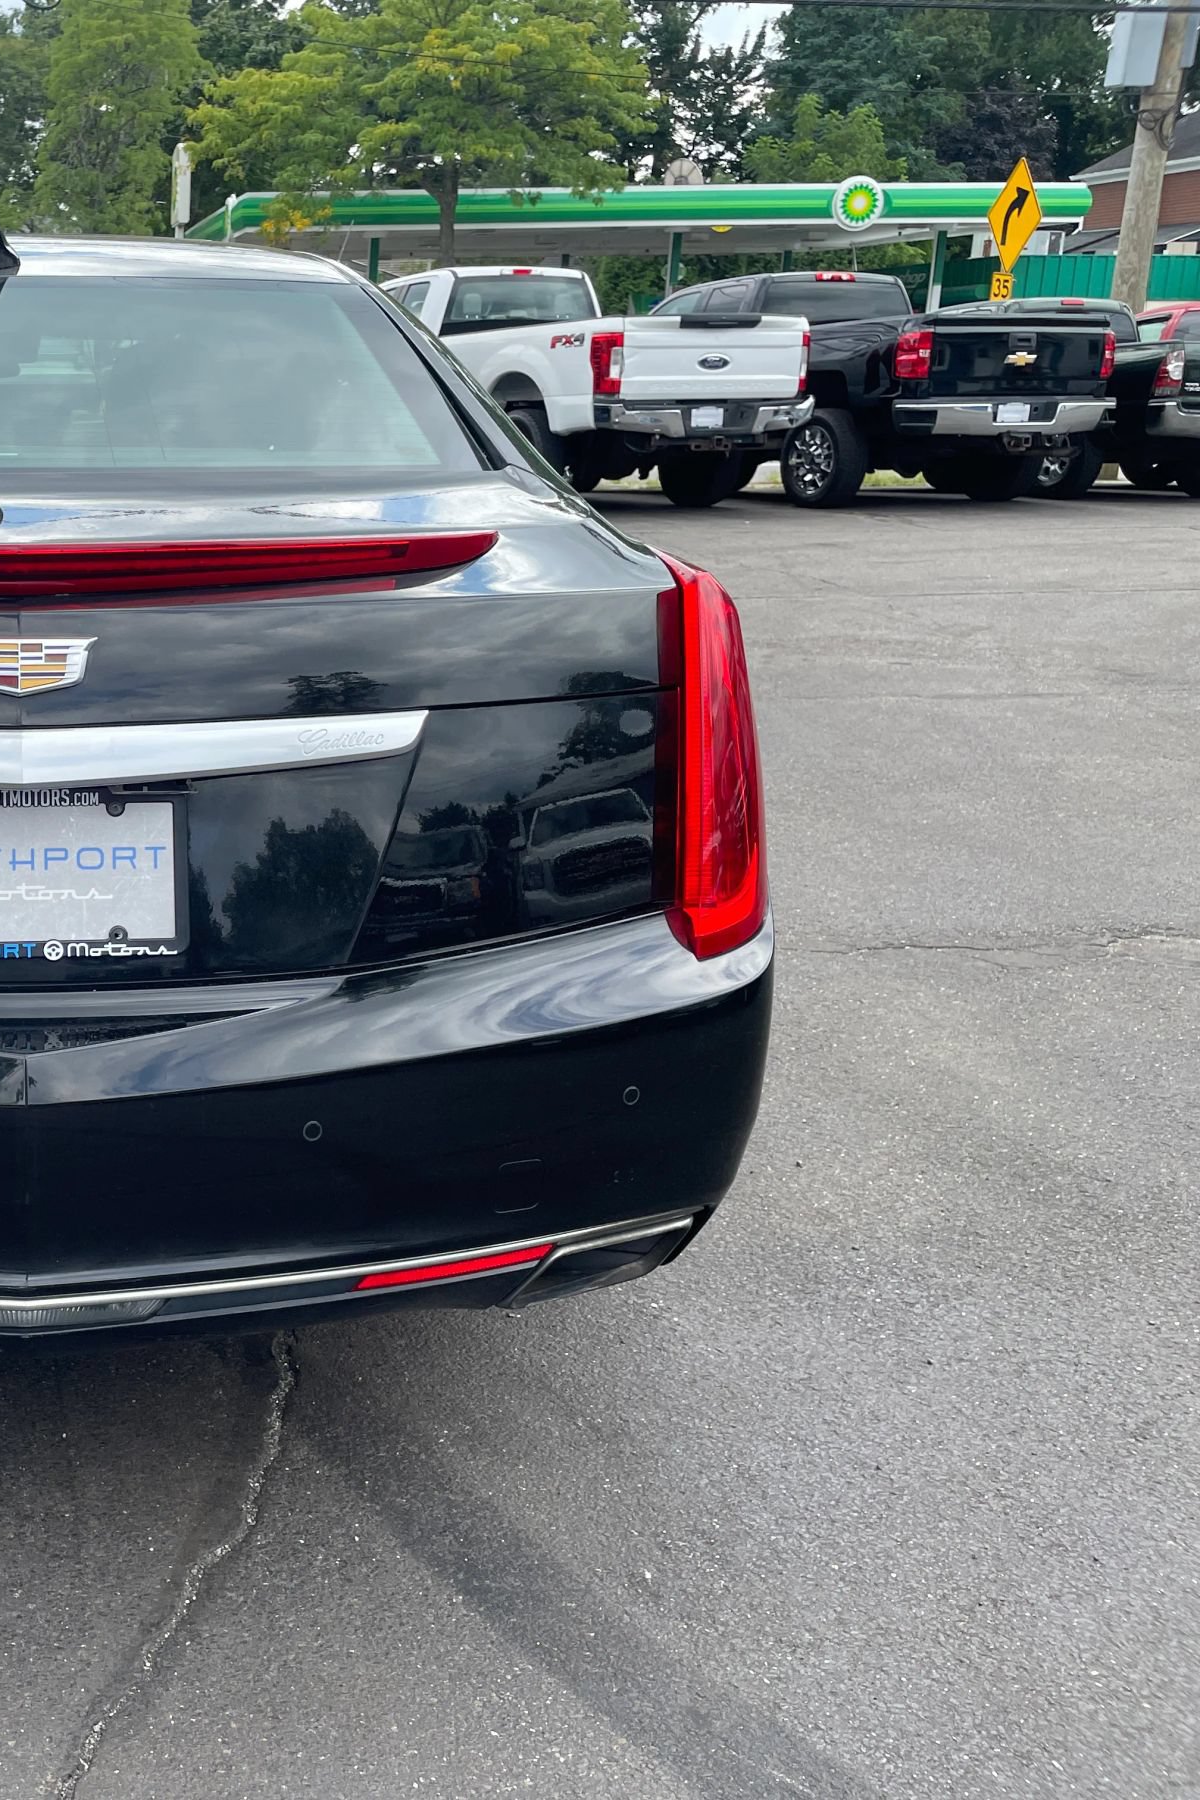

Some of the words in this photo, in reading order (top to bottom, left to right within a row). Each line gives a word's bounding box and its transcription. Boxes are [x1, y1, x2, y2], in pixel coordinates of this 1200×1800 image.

[993, 278, 1009, 298] 35
[550, 333, 585, 349] FX4
[297, 728, 385, 755] Cadillac
[66, 941, 178, 957] Motors
